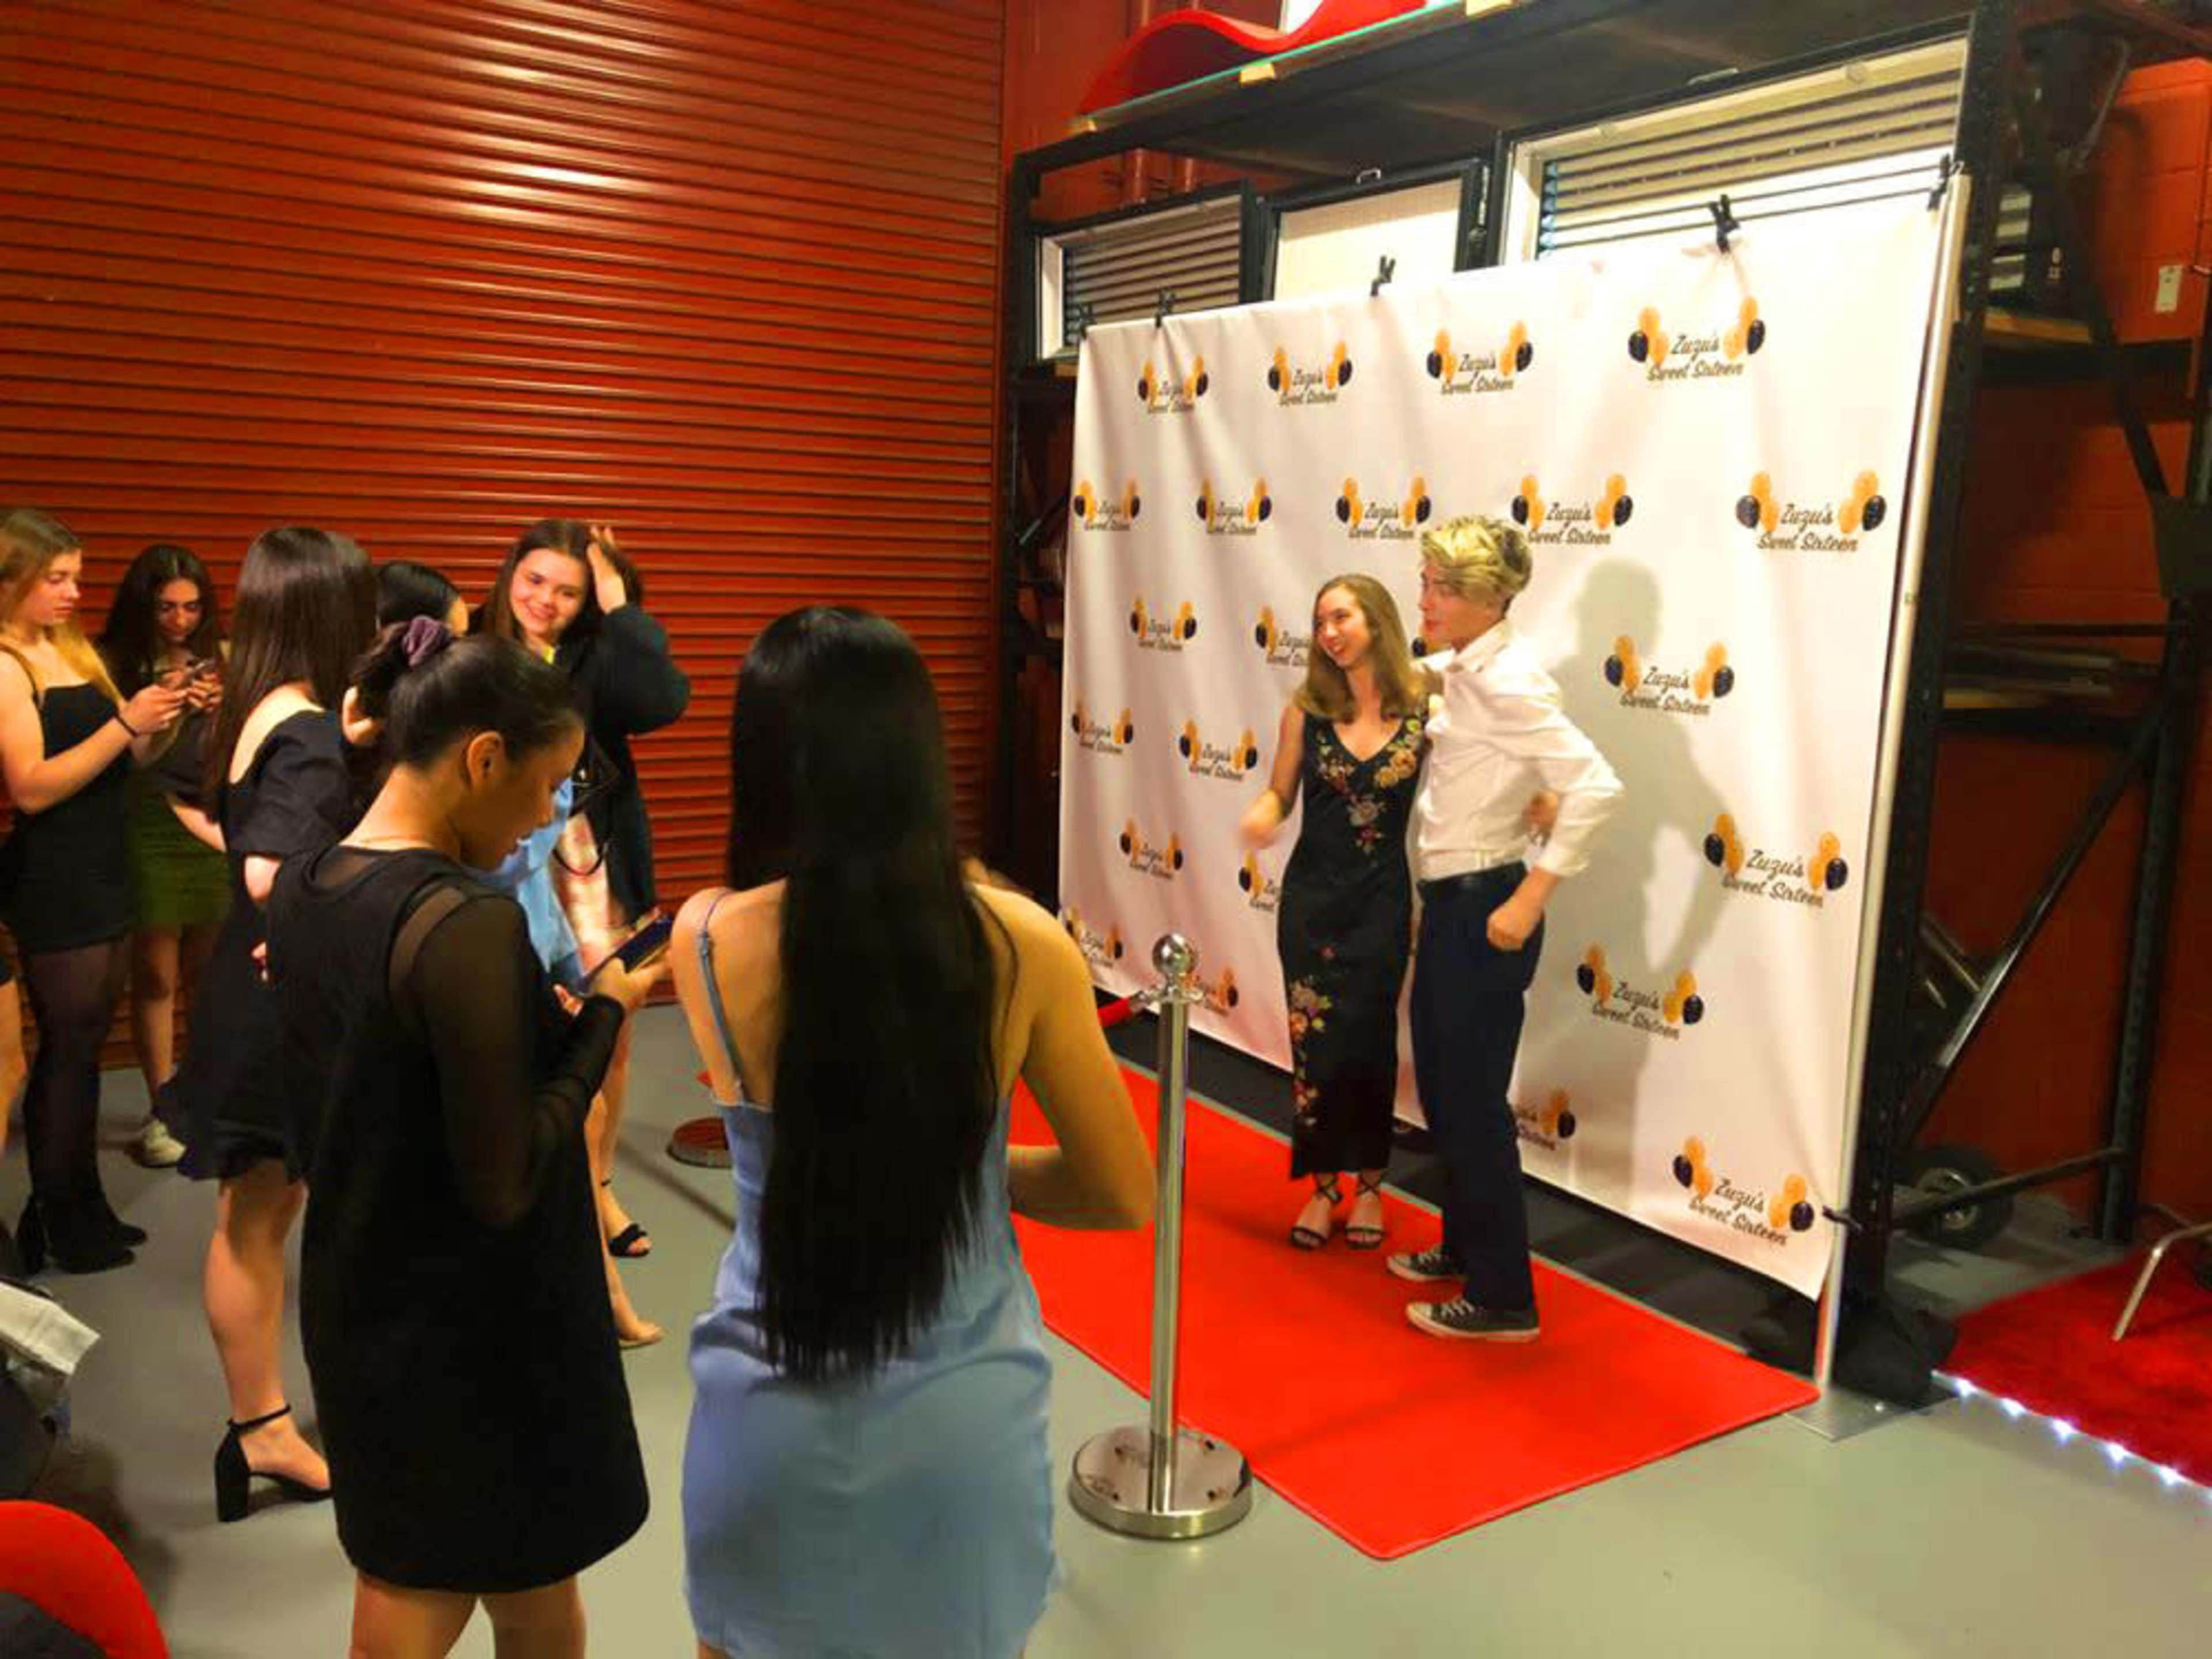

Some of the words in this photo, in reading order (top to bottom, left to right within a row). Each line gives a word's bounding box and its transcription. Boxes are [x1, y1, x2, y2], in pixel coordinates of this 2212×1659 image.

[1671, 331, 1719, 362] Zuzu's
[1646, 363, 1690, 381] Sweet
[1692, 359, 1744, 378] Sixteen
[1547, 502, 1591, 528] Zuzu's
[1781, 502, 1833, 533] Zuzu's
[1528, 529, 1564, 543] Sweet
[1566, 528, 1611, 544] Sixteen
[1756, 532, 1798, 549] Sweet
[1800, 532, 1858, 552] Sixteen
[1643, 666, 1688, 694] Zuzu's
[1620, 691, 1661, 709] Sweet
[1663, 693, 1710, 715] Sixteen
[1746, 849, 1804, 880] Zuzu's
[1721, 874, 1766, 895] Sweet
[1769, 882, 1823, 908] Sixteen
[1613, 981, 1660, 1012] Zuzu's
[1592, 1002, 1630, 1024] Sweet
[1632, 1012, 1680, 1041] Sixteen
[1714, 1177, 1764, 1213] Zuzu's
[1688, 1195, 1732, 1224] Sweet
[1732, 1213, 1787, 1246] Sixteen
